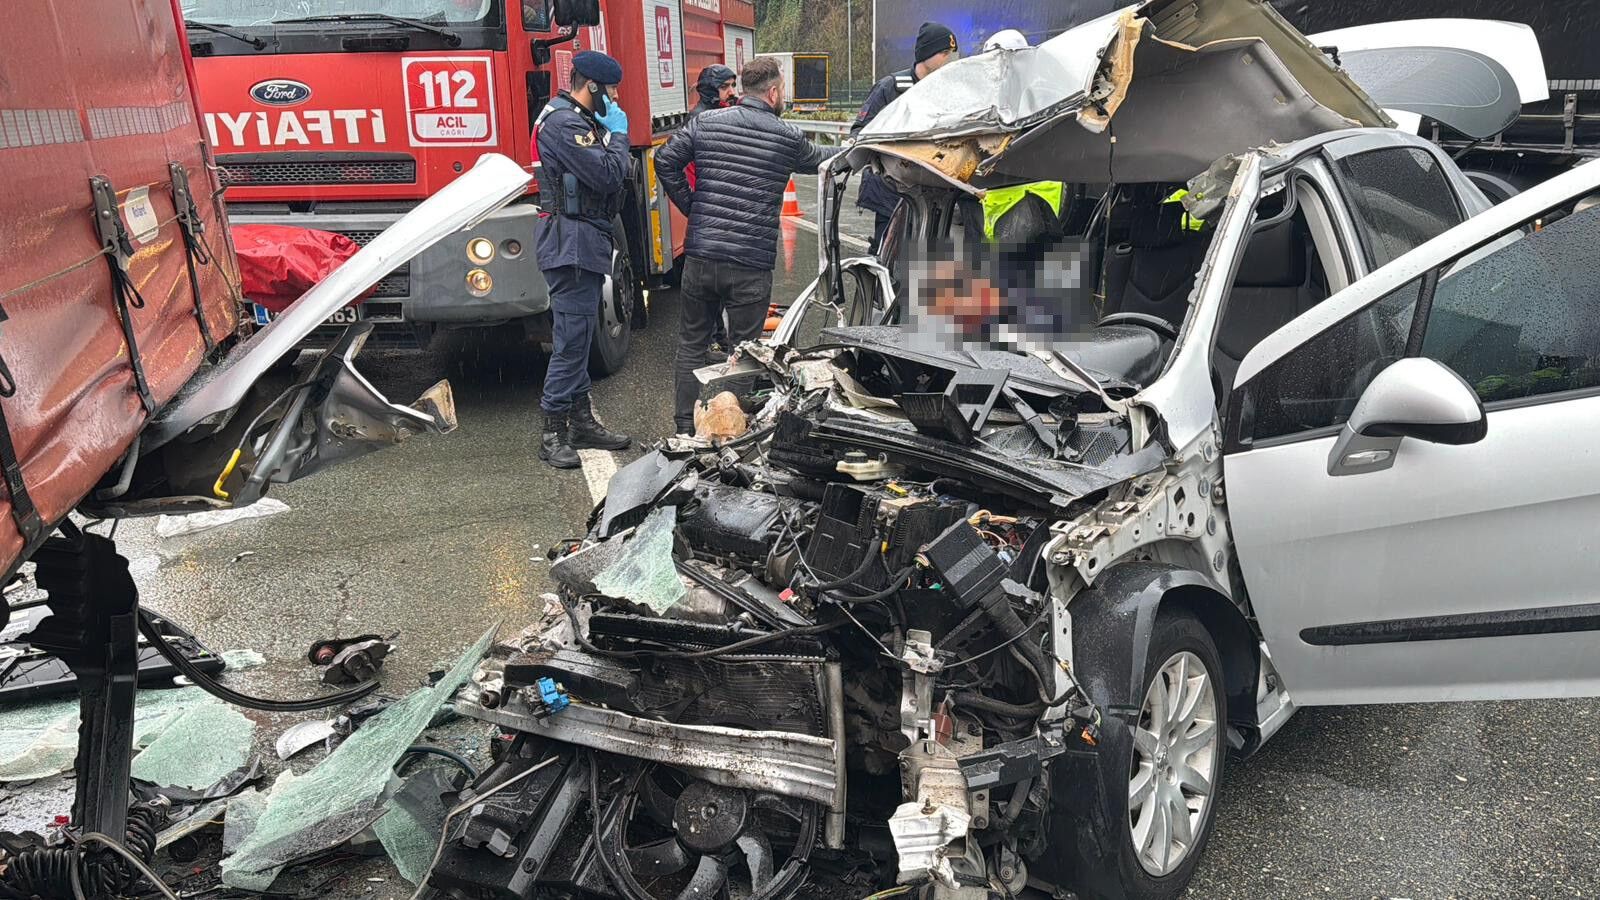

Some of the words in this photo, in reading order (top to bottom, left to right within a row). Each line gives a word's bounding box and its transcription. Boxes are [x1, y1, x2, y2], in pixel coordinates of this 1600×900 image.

[658, 15, 670, 53] 112
[263, 84, 297, 100] Ford
[419, 70, 478, 107] 112
[436, 116, 467, 128] ACİL
